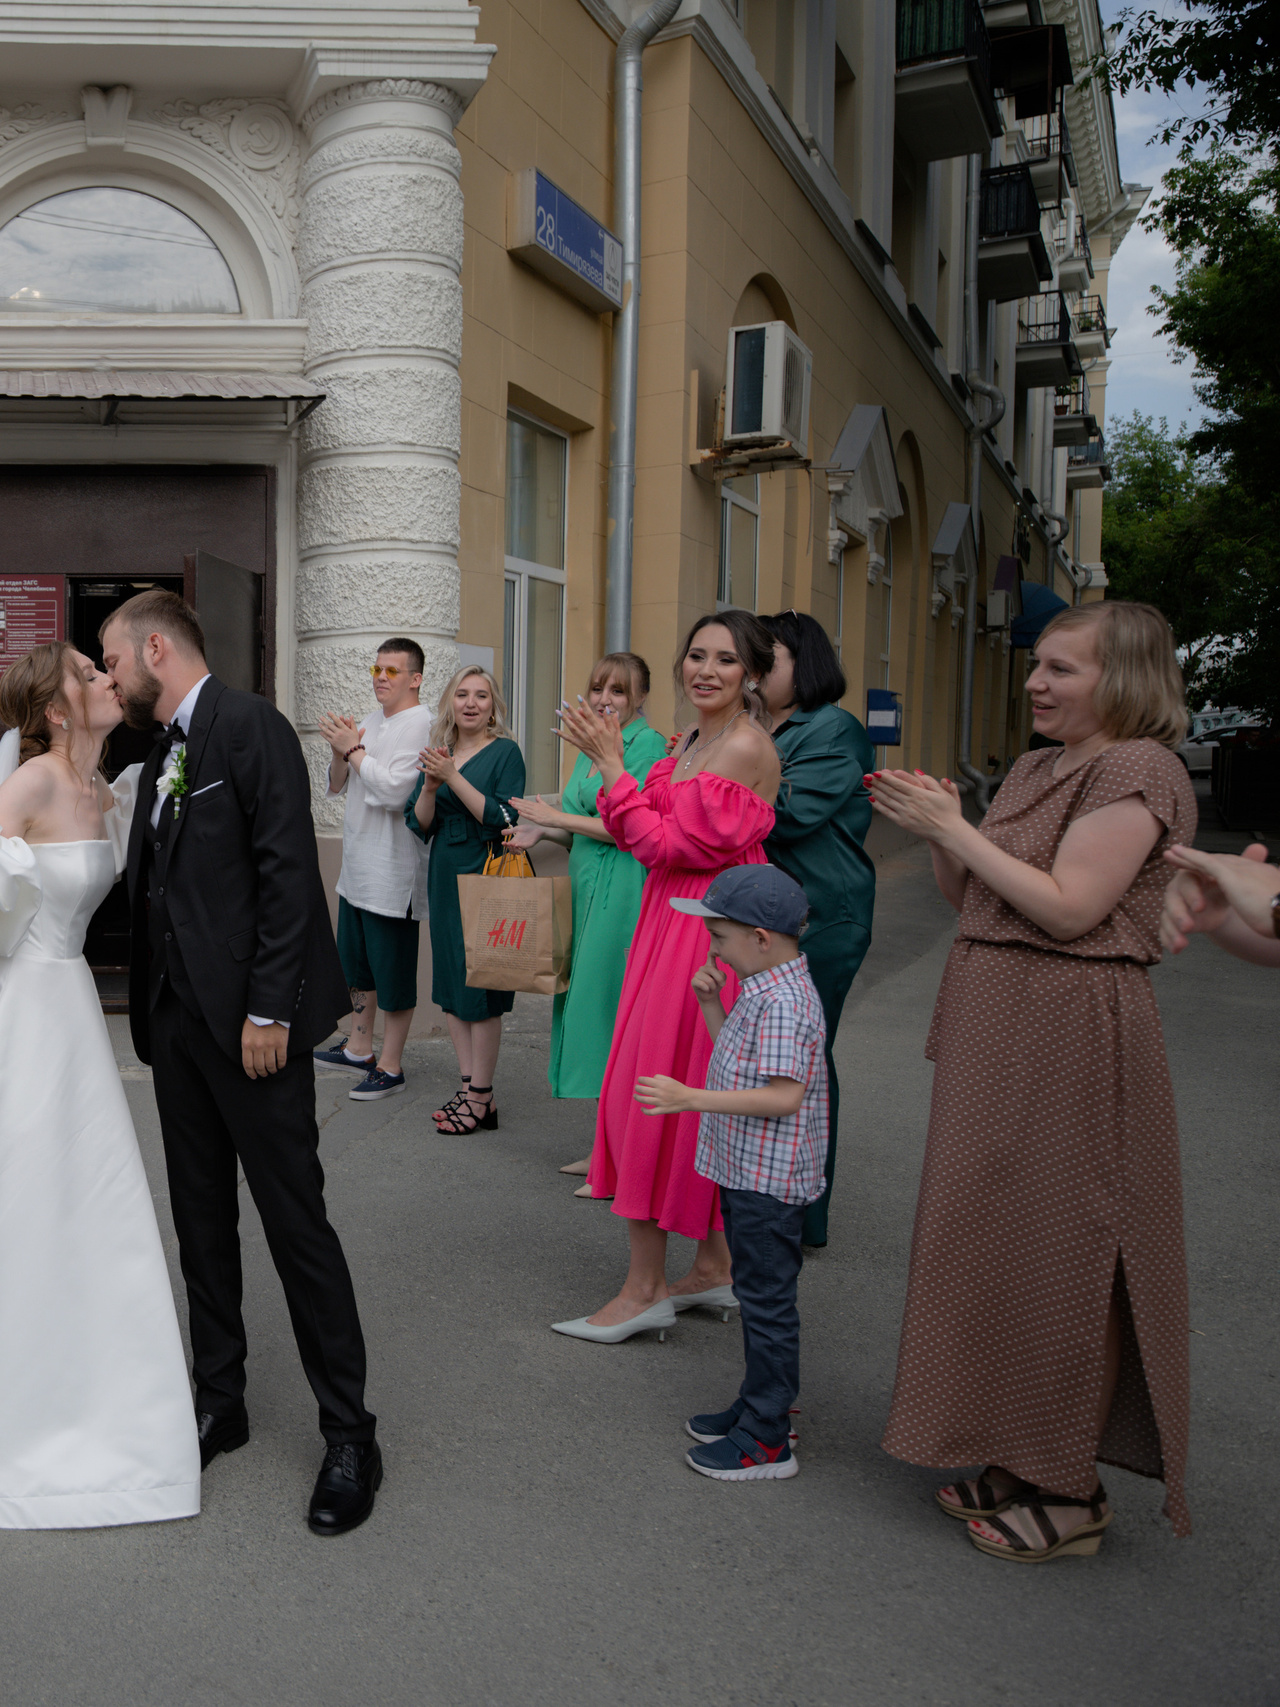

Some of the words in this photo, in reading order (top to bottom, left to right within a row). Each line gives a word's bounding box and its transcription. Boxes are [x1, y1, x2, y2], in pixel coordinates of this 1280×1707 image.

[537, 205, 555, 251] 28
[558, 235, 603, 286] Тимирязева
[486, 918, 527, 950] H&M
